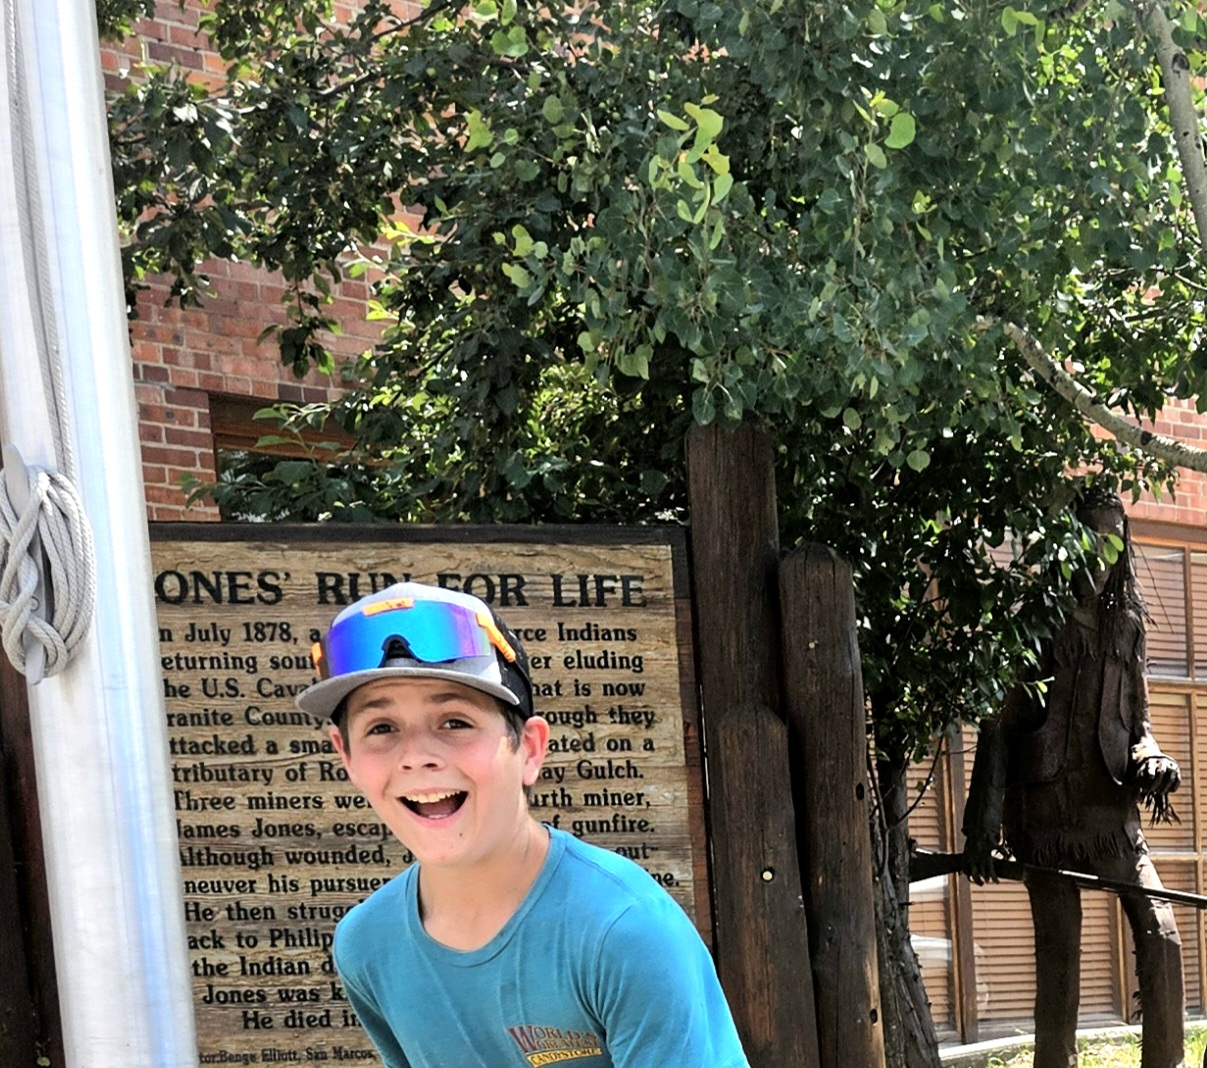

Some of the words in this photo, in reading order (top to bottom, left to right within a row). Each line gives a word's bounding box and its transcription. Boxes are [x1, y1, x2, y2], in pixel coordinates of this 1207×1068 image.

[154, 570, 291, 605] ONES'
[551, 574, 647, 608] LIFE
[159, 627, 173, 642] n
[185, 622, 231, 646] July
[242, 622, 298, 645] 1878,
[510, 627, 546, 642] rce
[557, 622, 637, 642] Indians
[161, 653, 257, 674] eturning
[530, 656, 552, 670] er
[563, 650, 643, 673] eluding
[164, 678, 191, 698] he
[201, 678, 245, 698] U.S.
[531, 679, 563, 697] hat
[574, 679, 591, 697] is
[602, 682, 645, 697] now
[166, 708, 233, 727] ranite
[536, 704, 597, 729] ough
[608, 705, 655, 729] they
[169, 735, 256, 755] ttacked
[266, 740, 278, 754] a
[289, 739, 335, 754] sma
[548, 732, 595, 752] ated
[606, 738, 632, 752] on
[643, 738, 655, 752] a
[171, 762, 273, 785] tributary
[285, 762, 308, 782] of
[319, 761, 349, 782] Ro
[577, 760, 644, 779] Gulch.
[174, 790, 236, 811] Three
[247, 792, 323, 810] miners
[530, 788, 572, 807] urth
[583, 789, 650, 809] miner,
[251, 818, 322, 840] Jones,
[332, 822, 393, 840] escap
[572, 814, 655, 836] gunfire.
[285, 844, 391, 867] wounded,
[184, 878, 256, 893] neuver
[268, 873, 299, 893] his
[310, 877, 392, 897] pursue
[184, 901, 214, 922] He
[226, 900, 276, 921] then
[287, 898, 365, 922] strug
[187, 929, 225, 950] ack
[236, 931, 258, 948] to
[270, 927, 333, 951] Philip
[192, 957, 229, 977] the
[240, 956, 310, 976] Indian
[203, 984, 266, 1005] Jones
[278, 987, 320, 1003] was
[242, 1010, 273, 1030] He
[284, 1009, 331, 1028] died
[305, 1047, 328, 1061] San
